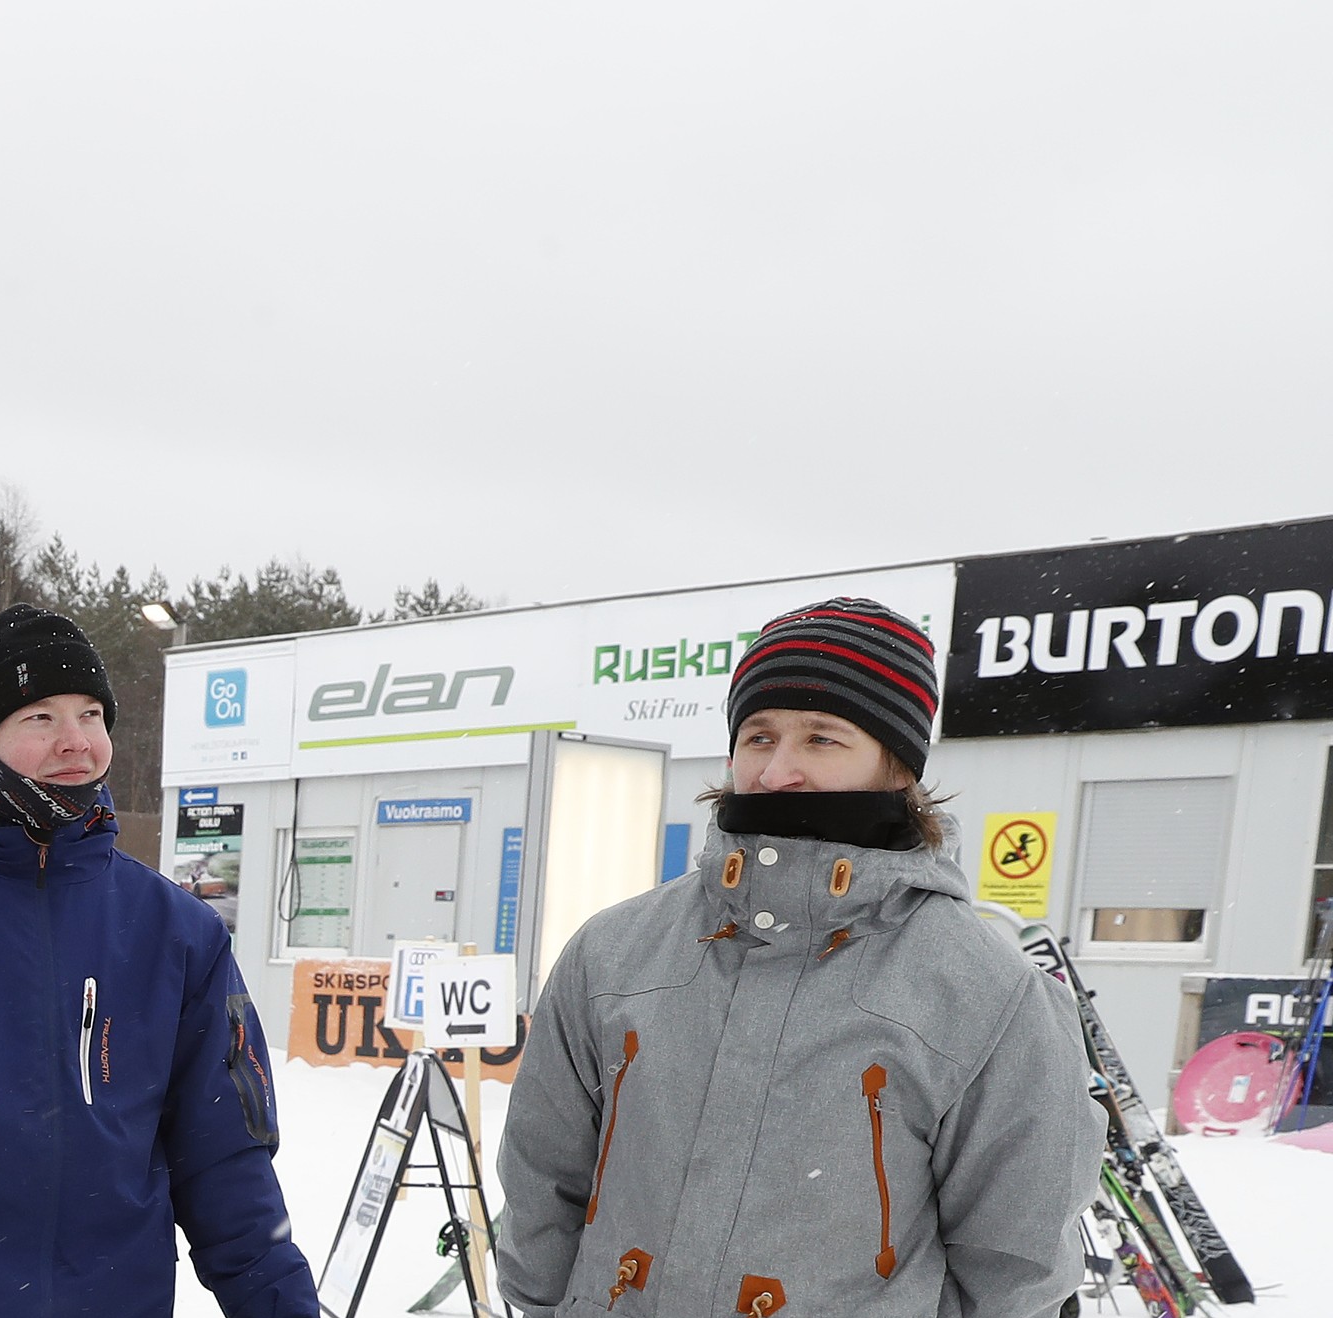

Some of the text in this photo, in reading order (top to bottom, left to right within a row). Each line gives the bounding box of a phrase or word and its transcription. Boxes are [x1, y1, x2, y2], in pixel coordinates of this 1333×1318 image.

[975, 589, 1326, 679] BURTON
[210, 678, 237, 699] Go
[308, 663, 514, 722] elan
[215, 698, 242, 719] On
[624, 699, 698, 721] SkiFun
[384, 804, 463, 820] Vuokraamo
[441, 979, 491, 1016] WC
[101, 1017, 112, 1084] TRUENORTH
